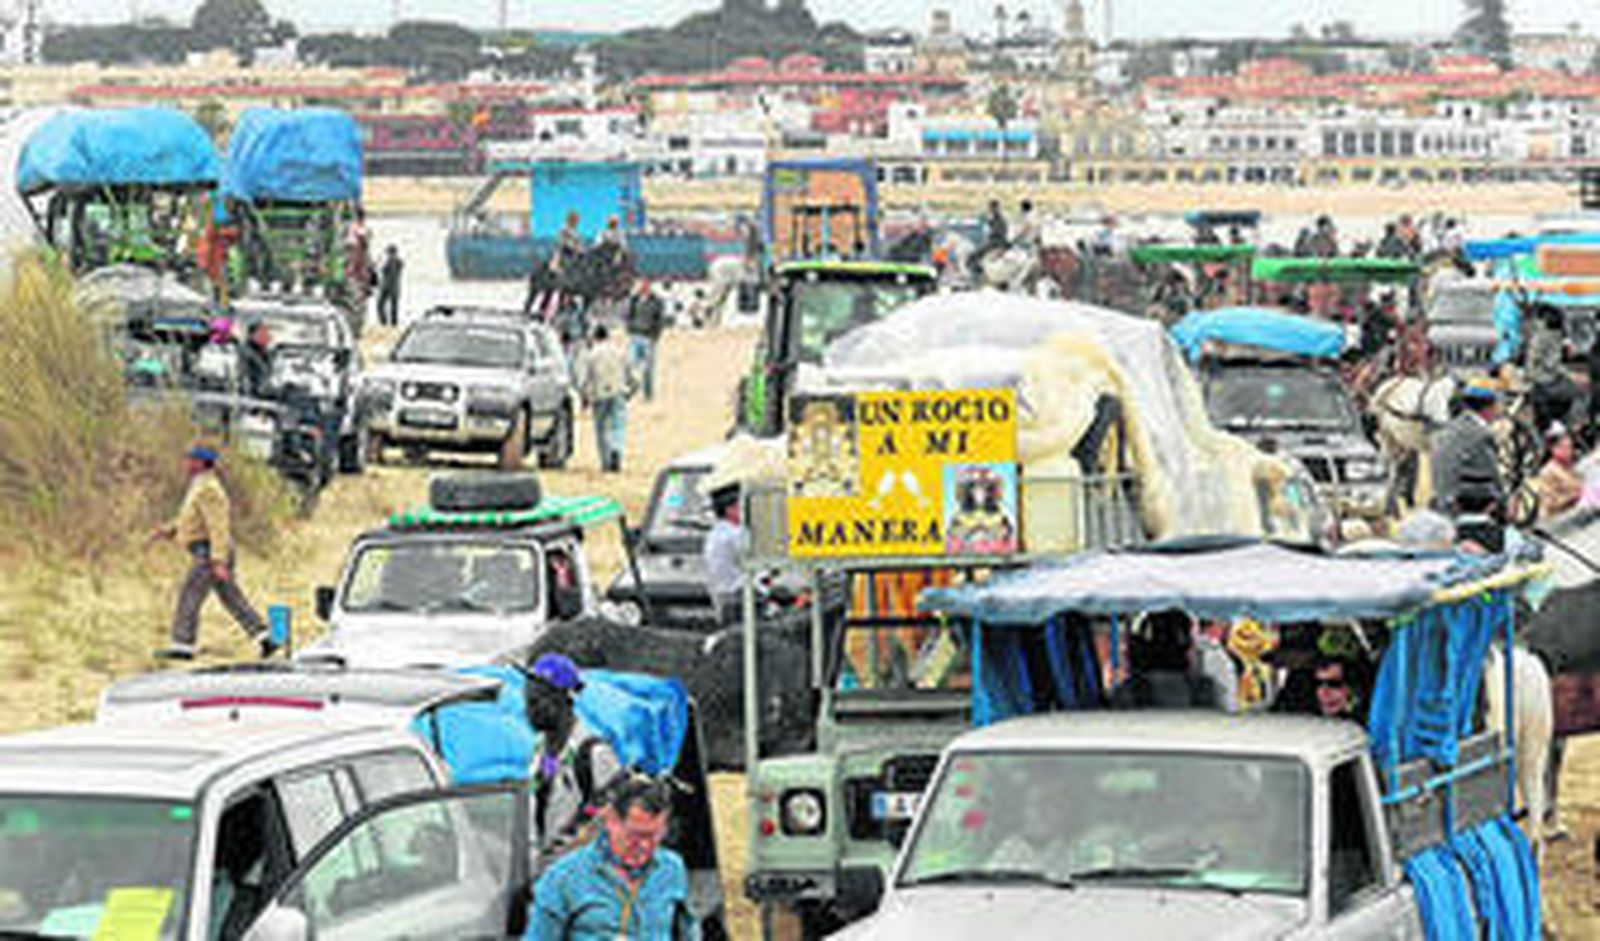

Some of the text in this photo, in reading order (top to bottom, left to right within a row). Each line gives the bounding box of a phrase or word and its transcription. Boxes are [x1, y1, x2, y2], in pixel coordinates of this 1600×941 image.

[860, 400, 901, 425] UN
[877, 430, 969, 455] A MI
[798, 519, 942, 545] MANERA
